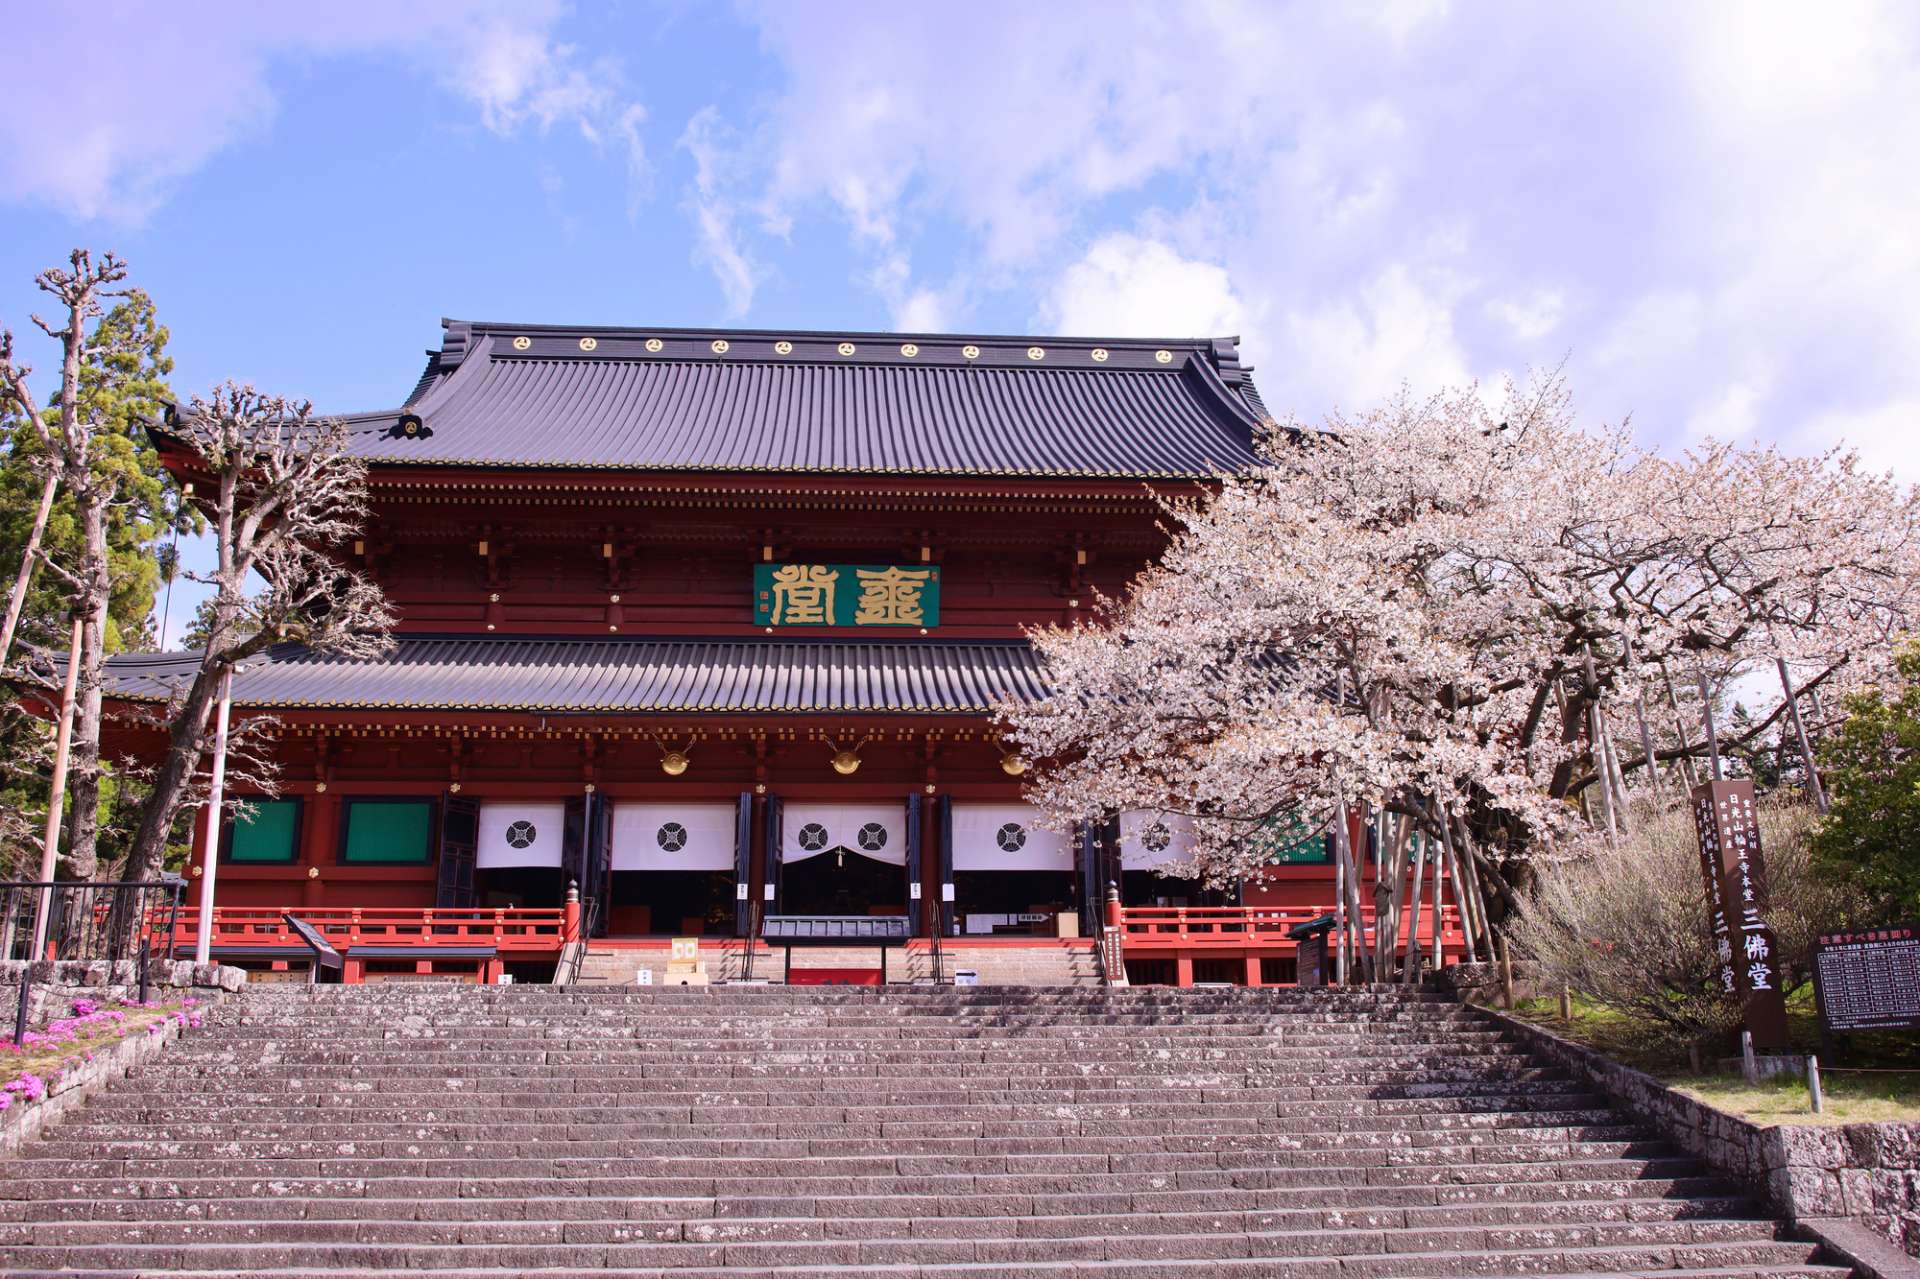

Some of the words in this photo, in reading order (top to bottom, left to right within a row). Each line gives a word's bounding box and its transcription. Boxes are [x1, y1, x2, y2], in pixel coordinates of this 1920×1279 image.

[1719, 801, 1734, 849] 世界遺産
[1729, 794, 1755, 902] 日光山輪王寺本堂
[1743, 799, 1757, 849] 重要文化財
[1714, 911, 1736, 993] 三佛堂
[1740, 908, 1772, 990] 三佛堂
